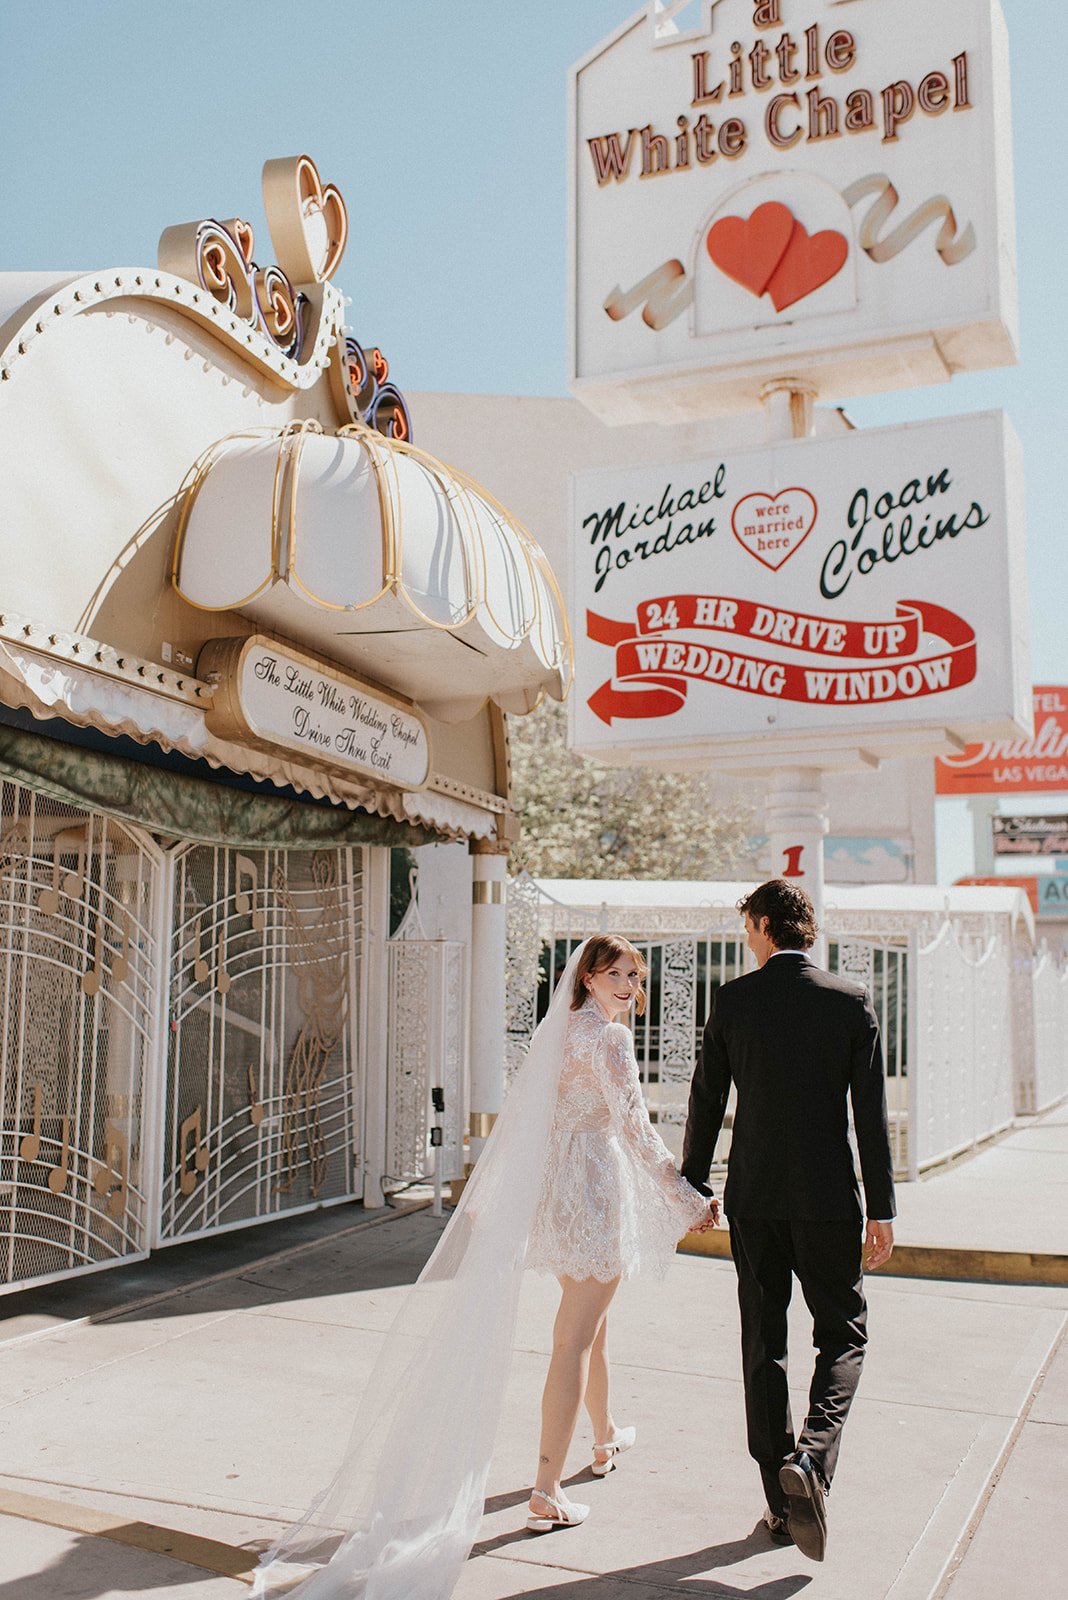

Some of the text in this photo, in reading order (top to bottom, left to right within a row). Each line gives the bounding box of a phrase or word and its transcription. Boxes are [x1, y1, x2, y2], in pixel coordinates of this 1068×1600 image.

[753, 0, 784, 30] a
[691, 22, 857, 107] Little
[587, 51, 973, 188] White Chapel
[582, 463, 727, 545] Michael
[743, 515, 805, 537] married
[754, 502, 790, 518] were
[847, 467, 954, 551] Joan
[594, 516, 717, 593] Jordan
[756, 533, 790, 551] here
[819, 502, 990, 599] Collins
[645, 598, 907, 655] 24 HR DRIVE UP
[254, 656, 420, 749] The Little White Wedding Chapel
[634, 643, 953, 702] WEDDING WINDOW
[293, 705, 392, 770] Drive Thru Exit
[993, 766, 1022, 783] LAS
[782, 845, 805, 877] 1
